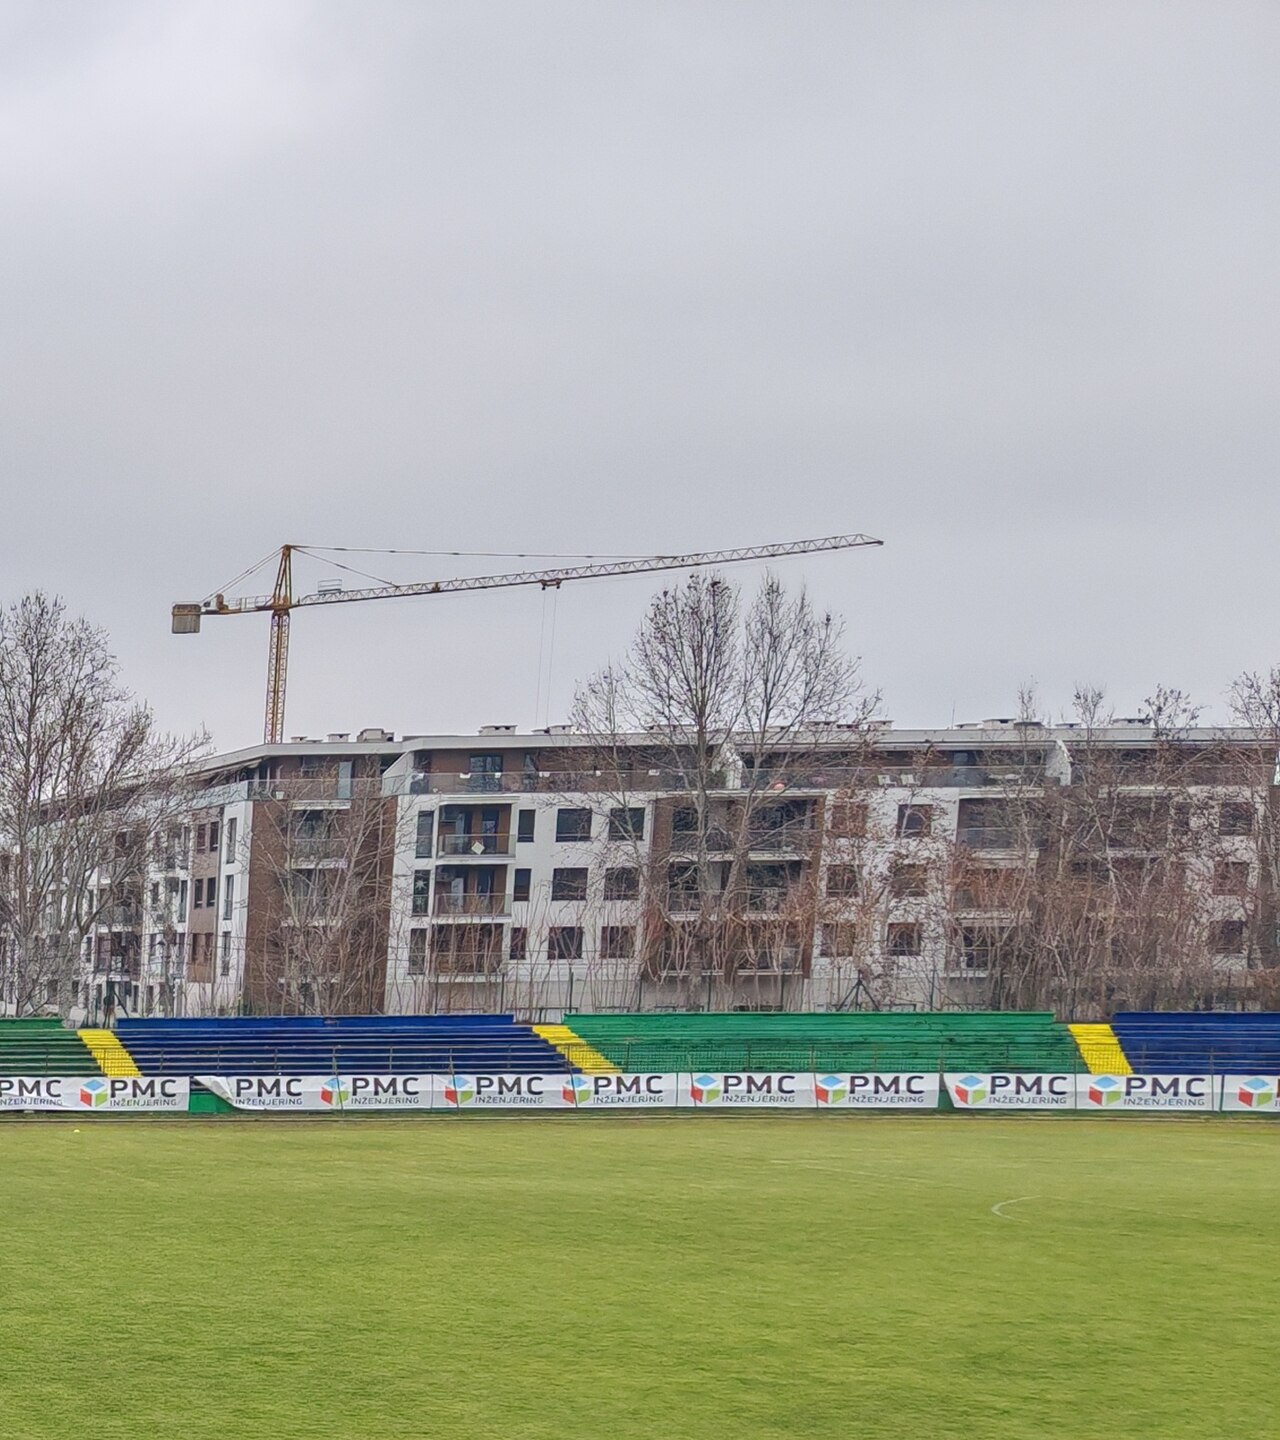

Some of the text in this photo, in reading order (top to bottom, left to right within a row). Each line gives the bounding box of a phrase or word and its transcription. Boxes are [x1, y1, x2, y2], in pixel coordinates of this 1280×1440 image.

[110, 1079, 177, 1098] PMC
[236, 1079, 302, 1097] PMC
[352, 1077, 419, 1096] PMC
[476, 1077, 544, 1095] PMC
[594, 1076, 663, 1095] PMC
[723, 1075, 795, 1094] PMC
[849, 1075, 924, 1094] PMC
[990, 1076, 1068, 1095] PMC
[1125, 1077, 1205, 1096] PMC
[110, 1098, 177, 1106] INŽENJERING
[236, 1098, 302, 1106] INŽENJERING
[351, 1096, 419, 1104] INŽENJERING
[475, 1095, 544, 1104] INŽENJERING
[593, 1095, 663, 1104] INŽENJERING
[722, 1093, 795, 1103] INŽENJERING
[848, 1094, 924, 1103] INŽENJERING
[989, 1095, 1068, 1105] INŽENJERING
[1124, 1096, 1205, 1106] INŽENJERING
